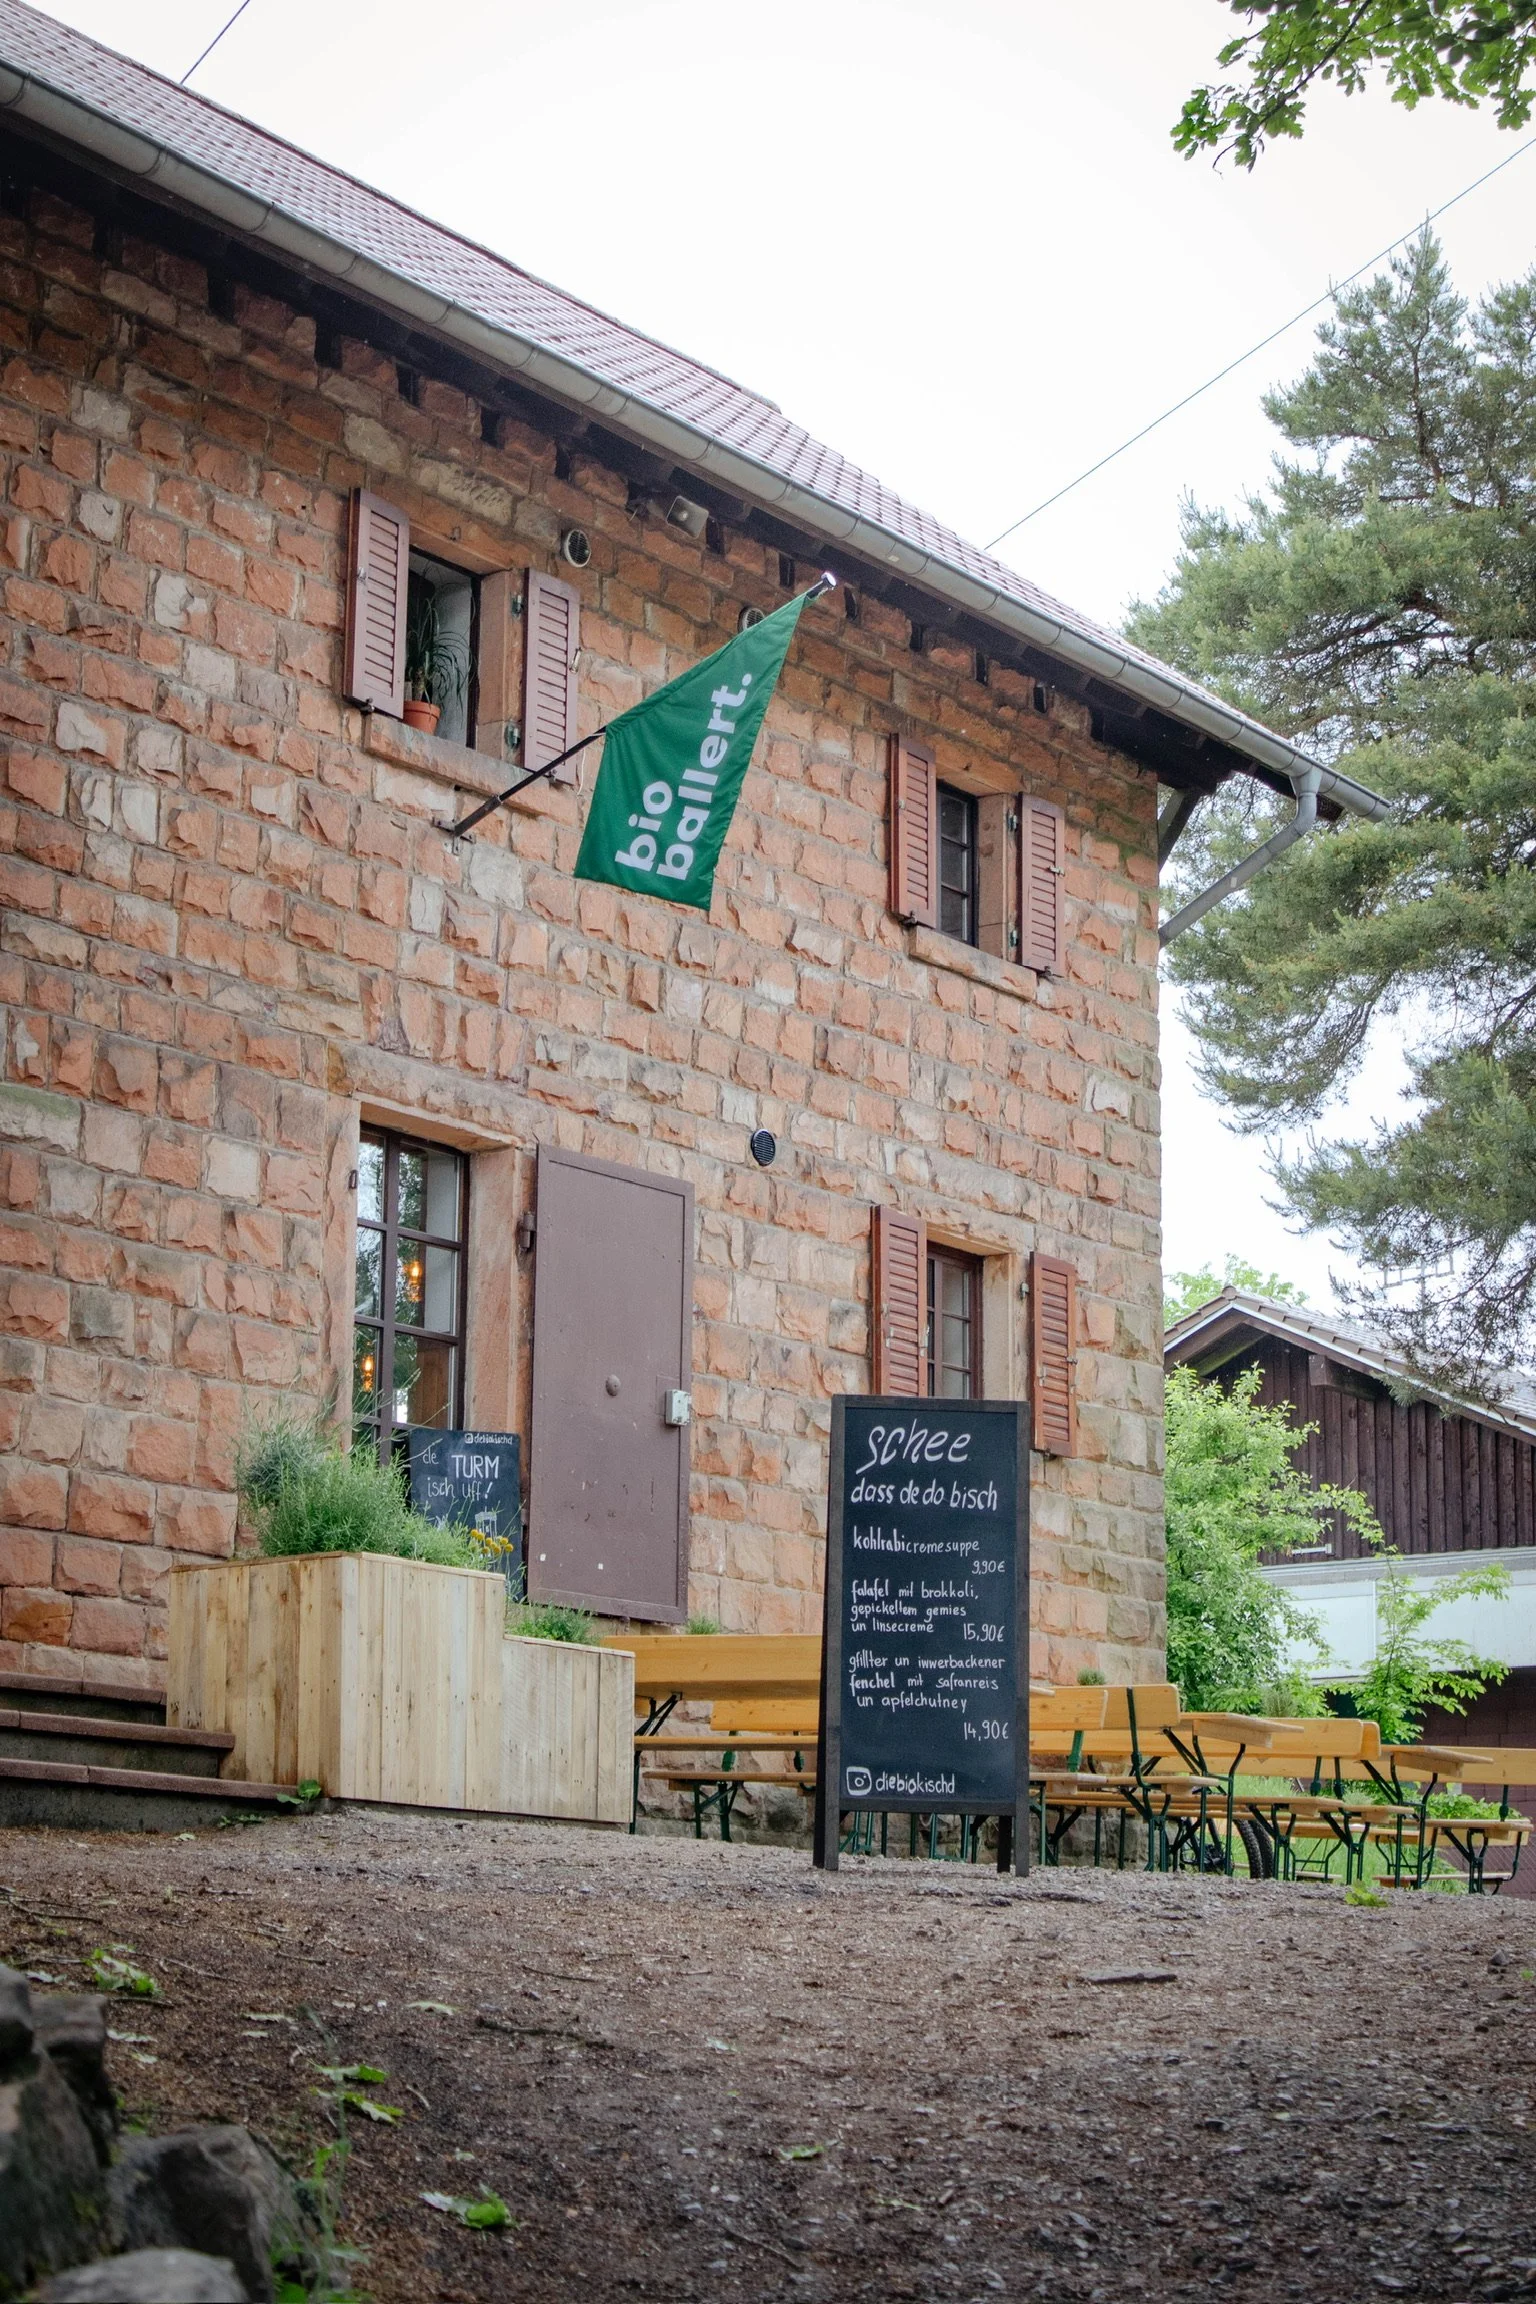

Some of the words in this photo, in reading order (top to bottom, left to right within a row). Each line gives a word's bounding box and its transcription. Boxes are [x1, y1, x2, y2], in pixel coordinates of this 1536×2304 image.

[657, 673, 752, 880] ballert.
[615, 781, 672, 872] bio
[856, 1418, 971, 1474] schee
[422, 1448, 439, 1464] de
[451, 1455, 500, 1479] TURM
[427, 1477, 455, 1498] isch
[851, 1478, 895, 1504] dass
[900, 1480, 920, 1505] de
[923, 1479, 944, 1505] do
[950, 1480, 997, 1511] bisch
[851, 1578, 889, 1603] falafel
[899, 1581, 914, 1597] mit
[922, 1581, 979, 1599] brokkoli,
[851, 1601, 917, 1622] gepickeltem
[924, 1604, 966, 1622] gemies
[852, 1621, 866, 1632] un
[873, 1618, 934, 1633] linsecreme
[963, 1623, 1004, 1642] 15,90€
[895, 1657, 909, 1666] un
[849, 1672, 895, 1697] fenchel
[908, 1675, 924, 1687] mit
[936, 1672, 999, 1691] safranreis
[857, 1695, 873, 1706] un
[882, 1693, 967, 1713] apfelchutney
[963, 1720, 1009, 1741] 14,90€
[876, 1771, 955, 1794] diebiokischd
